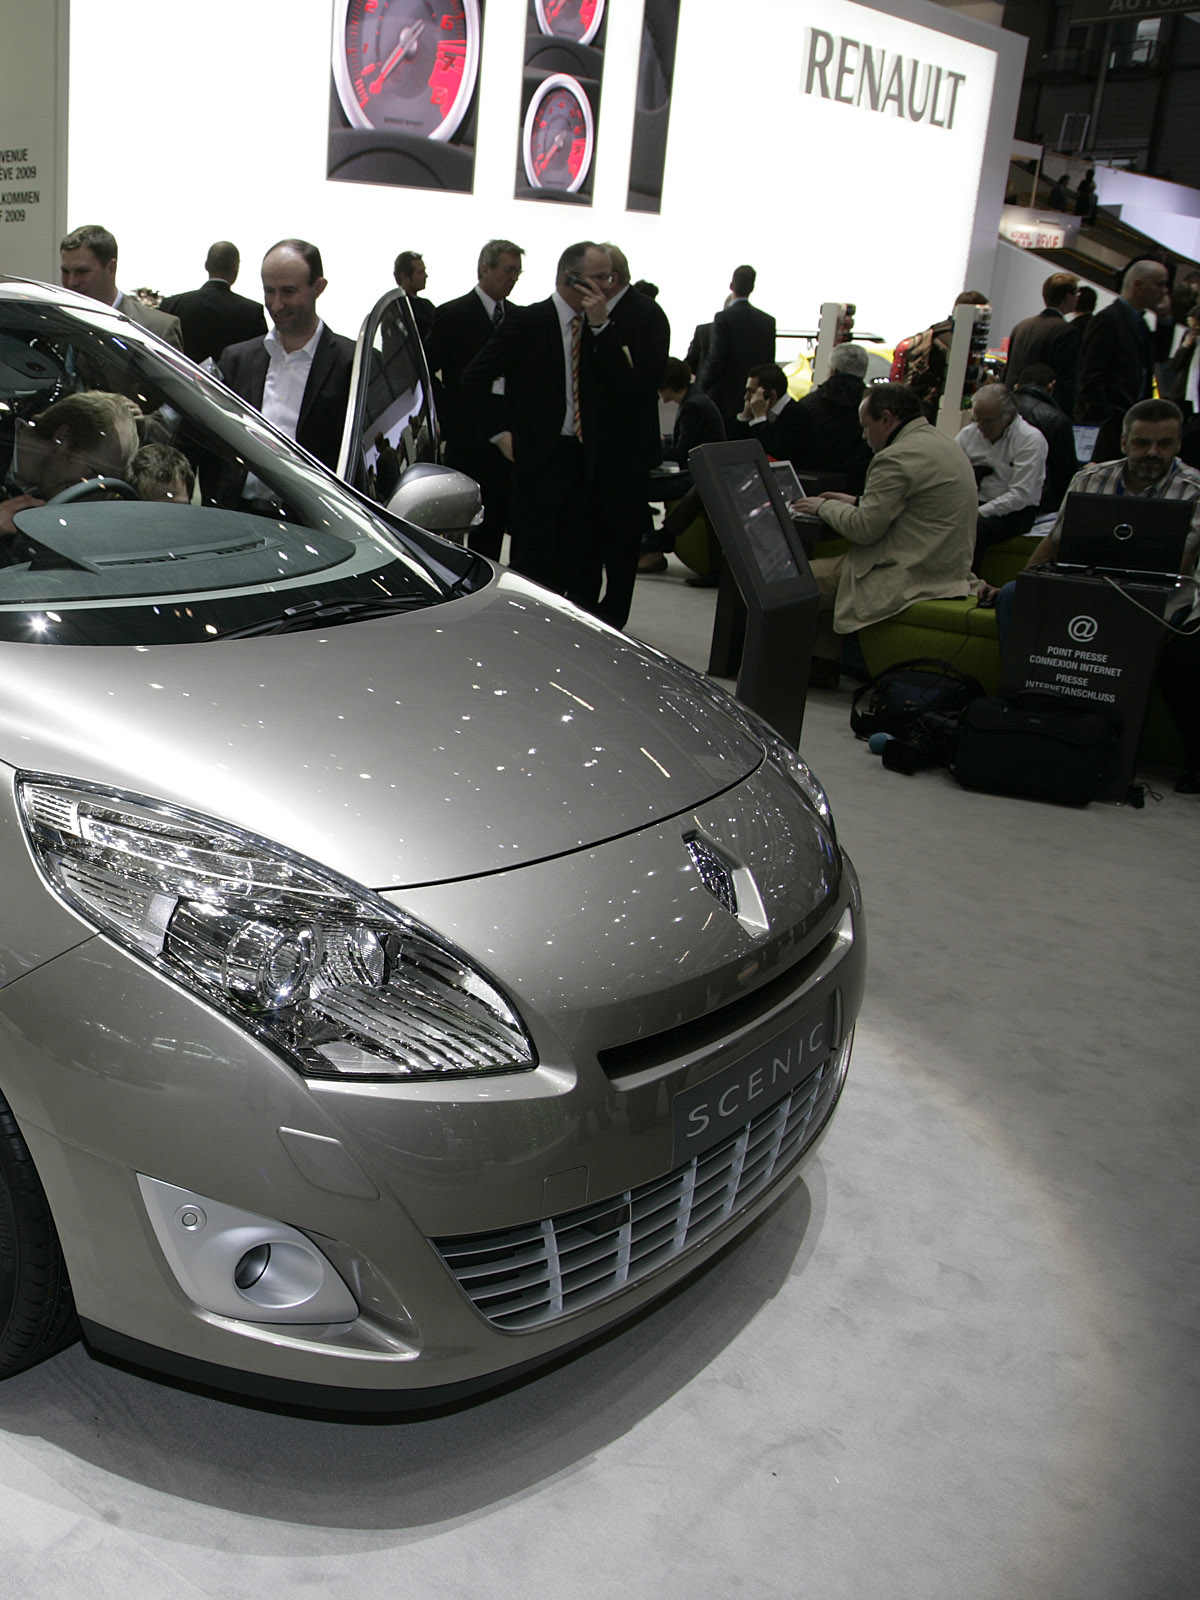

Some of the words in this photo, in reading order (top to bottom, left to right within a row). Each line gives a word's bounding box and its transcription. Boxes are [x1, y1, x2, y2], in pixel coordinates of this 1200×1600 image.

[440, 14, 454, 31] 6
[801, 27, 967, 130] RENAULT
[15, 166, 37, 179] 2009
[5, 209, 26, 222] 2009
[1068, 615, 1098, 643] @
[1047, 646, 1073, 657] POINT
[1074, 650, 1109, 663] PRESSE
[1029, 654, 1078, 670] CONNEXION
[1079, 663, 1122, 677] INTERNET
[1055, 673, 1089, 686] PRESSE
[686, 1022, 824, 1138] SCENIC
